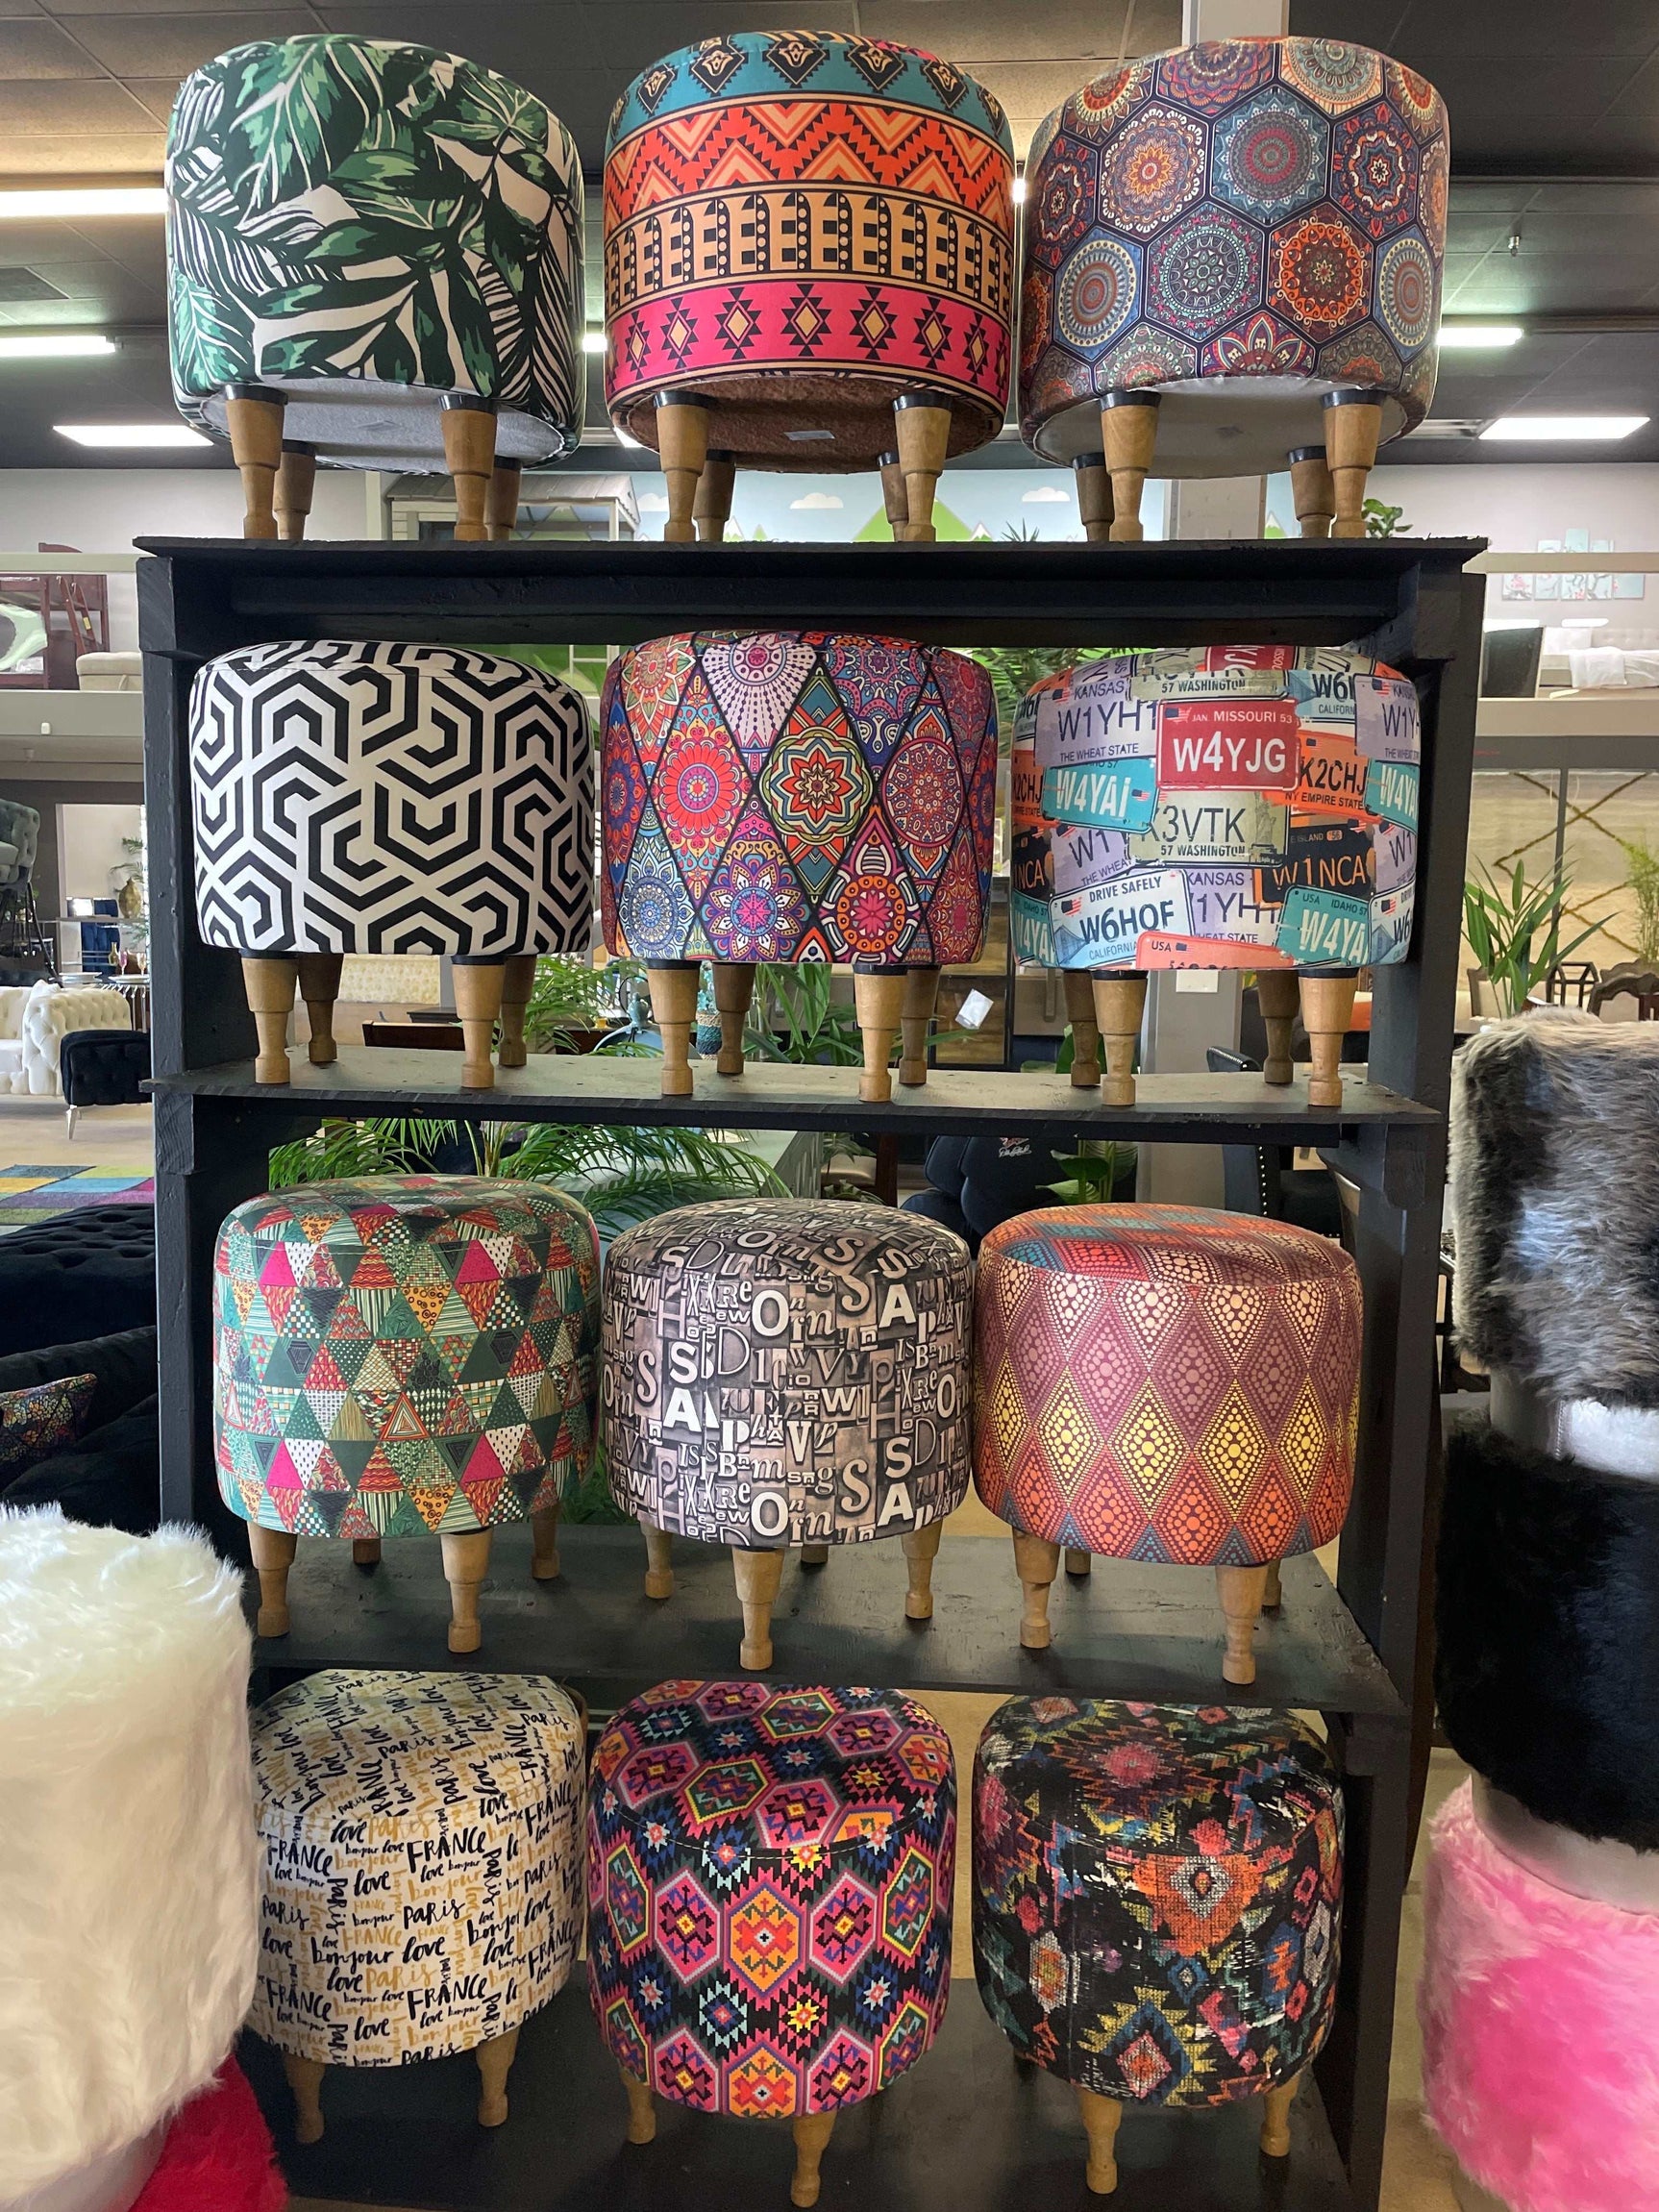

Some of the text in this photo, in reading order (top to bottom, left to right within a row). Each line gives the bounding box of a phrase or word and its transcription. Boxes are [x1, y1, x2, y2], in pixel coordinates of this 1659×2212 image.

[1074, 681, 1125, 700] KANSAS
[1162, 679, 1246, 694] 57 WASHINGTON
[1214, 711, 1276, 722] MISSOURI
[1279, 714, 1293, 724] 53
[1060, 743, 1139, 762] THE WHEAT STATE
[1173, 731, 1286, 773] W4YJG
[1301, 792, 1335, 805] EMPIRE
[1338, 797, 1364, 810] STATE
[1161, 844, 1246, 857] 57 WASHINGTON
[1081, 871, 1099, 886] THE
[1273, 855, 1367, 890] W1NCA
[1089, 876, 1162, 903] DRIVE SAFELY
[1302, 894, 1321, 905] USA
[1330, 899, 1358, 913] IDAHO
[1151, 941, 1172, 952] USA
[330, 1818, 367, 1844] love
[382, 1839, 405, 1853] love
[275, 1862, 293, 1880] love
[421, 1864, 444, 1883] love
[354, 1869, 391, 1897] love
[261, 1926, 293, 1959] love
[483, 1935, 515, 1966] love
[310, 1936, 394, 1975] bonjour
[402, 1936, 445, 1964] love
[327, 1966, 363, 1993] love
[382, 1990, 405, 2002] love
[354, 2016, 391, 2042] love
[420, 2010, 443, 2029] love
